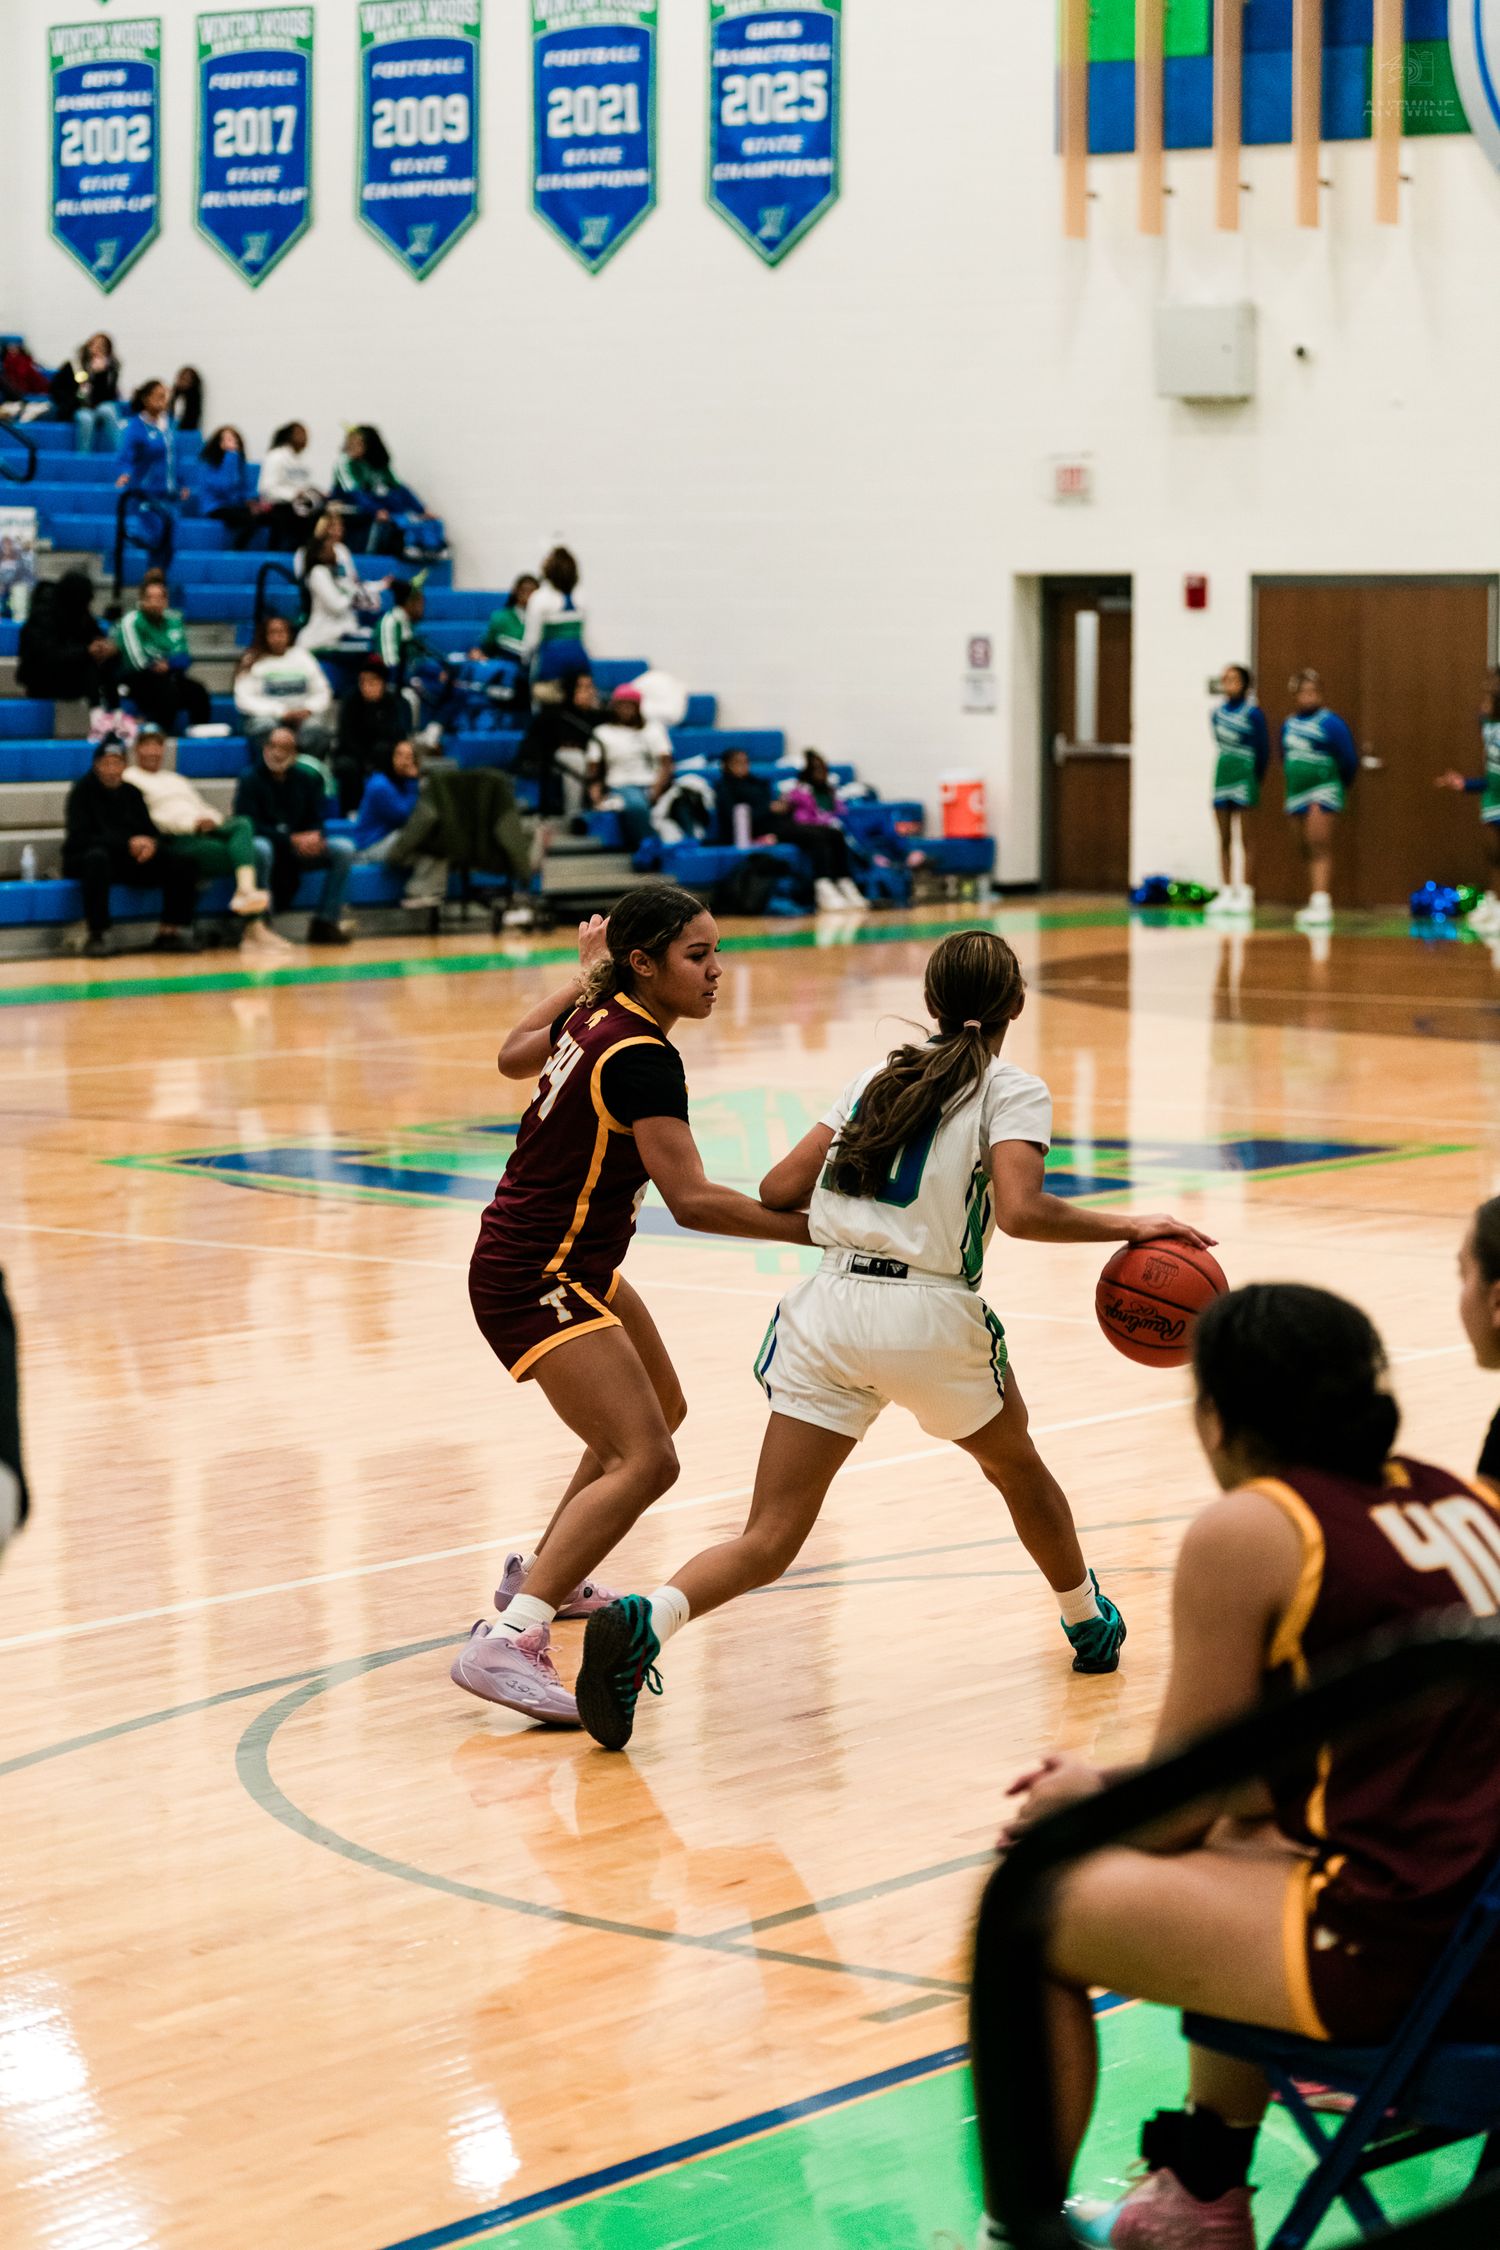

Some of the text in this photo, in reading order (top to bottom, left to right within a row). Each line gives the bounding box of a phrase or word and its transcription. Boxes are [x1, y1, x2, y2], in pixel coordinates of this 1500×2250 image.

[543, 45, 640, 68] FOOTBALL
[208, 69, 298, 91] FOOTBALL
[371, 57, 465, 80] FOOTBALL
[721, 69, 828, 126] 2025
[372, 93, 470, 149] 2009
[546, 82, 641, 138] 2021
[60, 114, 151, 166] 2002
[213, 104, 298, 158] 2017
[741, 134, 804, 155] STATE
[390, 155, 448, 176] STATE
[562, 146, 623, 167] STATE
[79, 173, 130, 193] STATE
[226, 165, 282, 185] STATE
[539, 1284, 573, 1323] T
[1104, 1298, 1186, 1342] Rawlings
